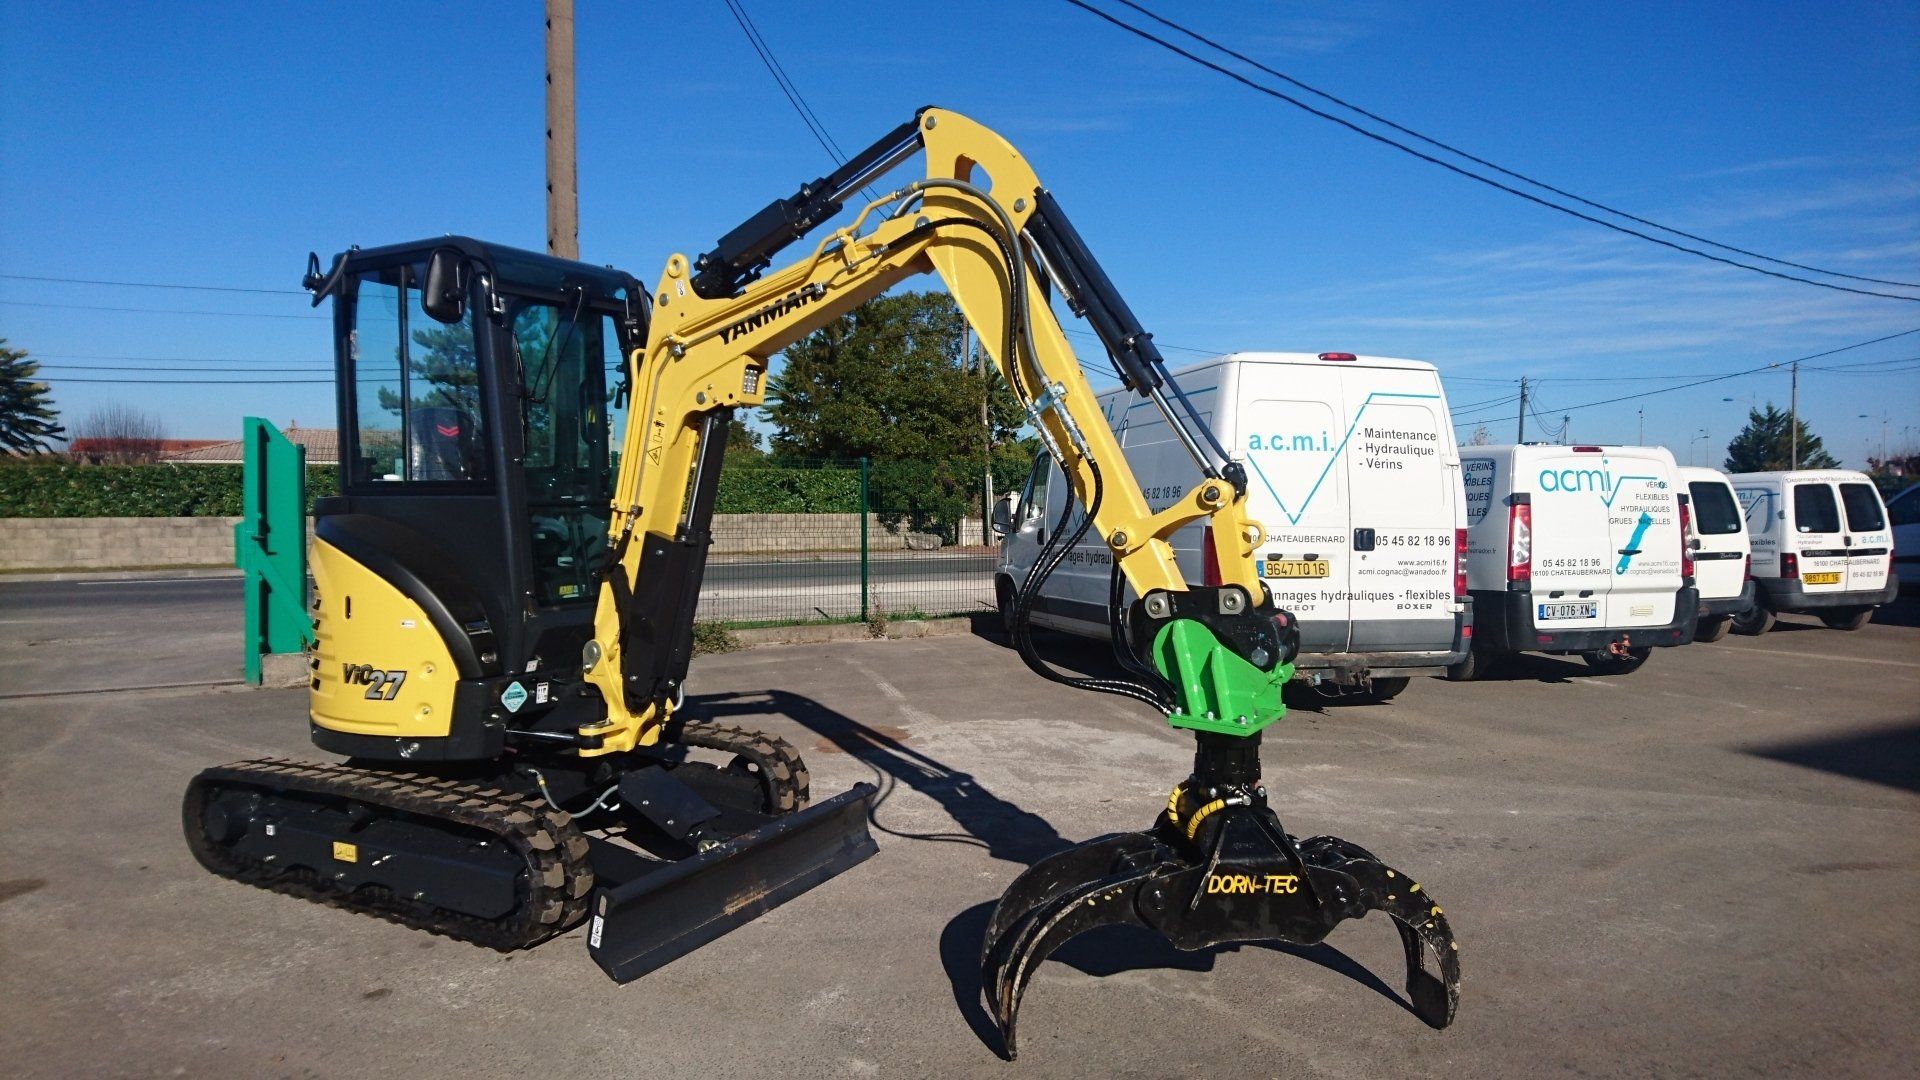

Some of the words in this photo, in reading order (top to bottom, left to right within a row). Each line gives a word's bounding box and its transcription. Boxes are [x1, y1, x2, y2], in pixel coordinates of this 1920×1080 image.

[718, 282, 817, 345] YANMAR
[1364, 427, 1437, 441] Maintenance
[1248, 430, 1335, 452] a.c.m.i.
[1365, 442, 1434, 458] Hydraulique
[1366, 457, 1403, 470] Vérins
[1539, 459, 1611, 493] acmi
[1152, 487, 1161, 499] 82
[1163, 486, 1171, 498] 18
[1172, 485, 1182, 498] 96
[1635, 493, 1670, 501] FLEXIBLES
[1620, 505, 1671, 513] HYDRAULIQUES
[1609, 517, 1633, 525] GRUES
[1265, 534, 1346, 544] CHATEAUBERNARD
[1375, 535, 1389, 547] 05
[1391, 535, 1405, 547] 45
[1407, 535, 1421, 547] 82
[1424, 535, 1435, 547] 18
[1438, 535, 1451, 547] 96
[1266, 563, 1294, 576] 9647
[1313, 563, 1326, 576] 16
[1542, 559, 1553, 568] 05
[1555, 559, 1565, 567] 45
[1567, 559, 1577, 567] 82
[1579, 558, 1588, 567] 18
[1590, 558, 1601, 567] 96
[1550, 568, 1611, 577] CHATEAUBERNARD
[1321, 590, 1394, 603] hydrauliques
[1406, 589, 1451, 600] flexibles
[1207, 874, 1298, 894] DORN-TEC
